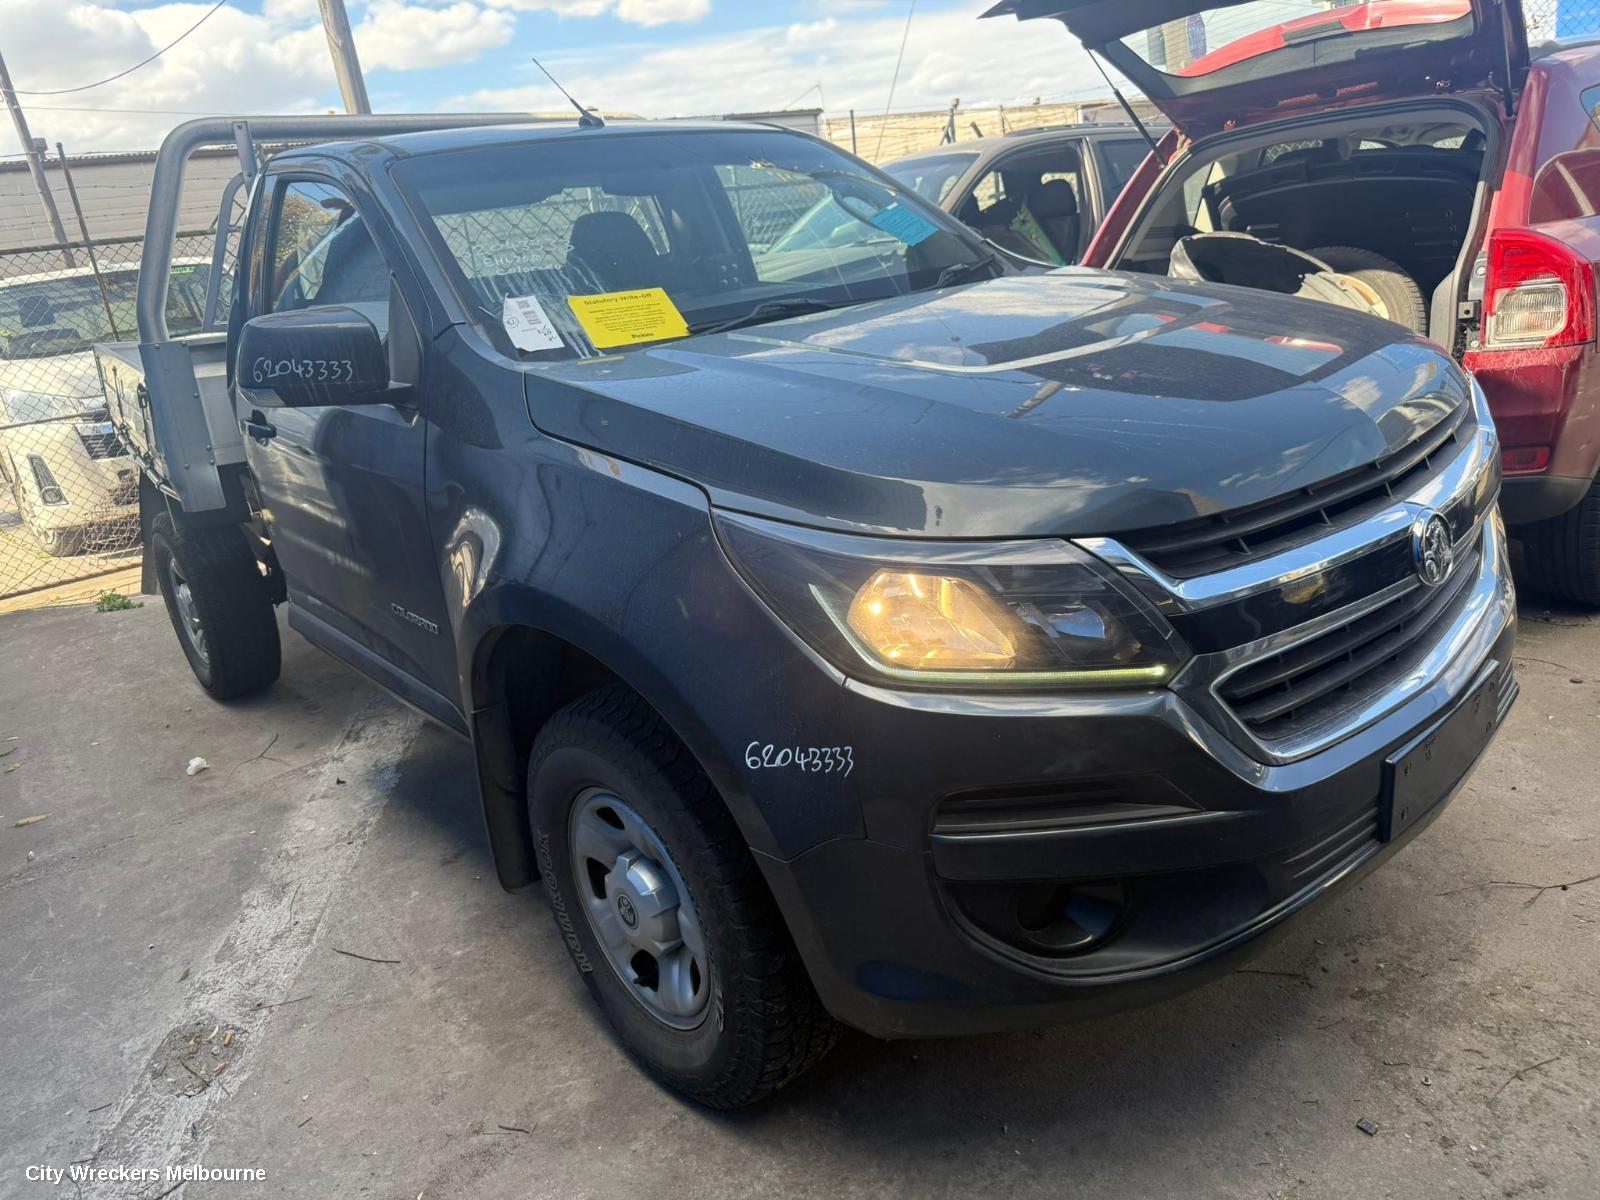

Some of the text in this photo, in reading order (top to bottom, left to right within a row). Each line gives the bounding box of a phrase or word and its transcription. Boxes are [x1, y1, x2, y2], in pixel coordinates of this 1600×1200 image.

[583, 292, 652, 306] Statutory Write-Off
[631, 331, 654, 340] Pickles
[252, 356, 353, 383] 62043333
[745, 741, 854, 778] 62043333
